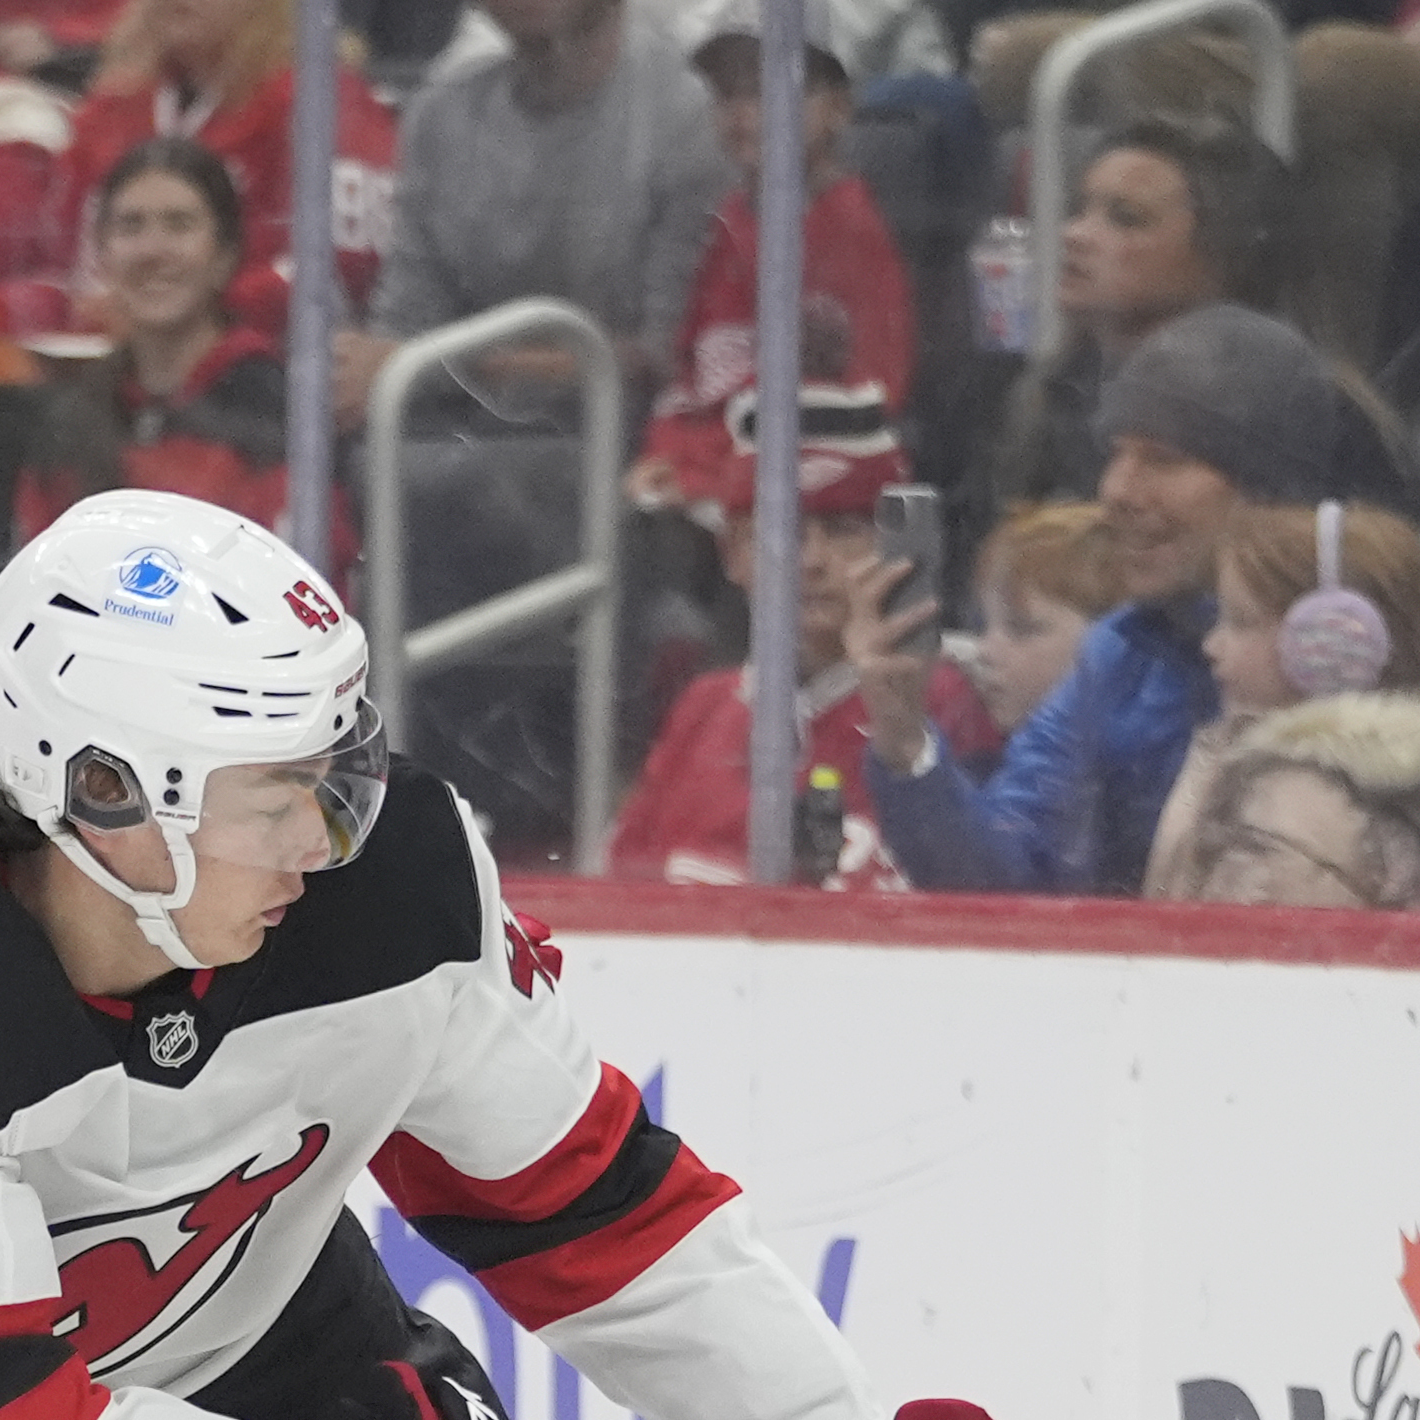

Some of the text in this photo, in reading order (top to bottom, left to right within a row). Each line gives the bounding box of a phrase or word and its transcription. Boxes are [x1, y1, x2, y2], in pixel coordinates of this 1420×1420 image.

[104, 598, 174, 627] Prudential
[282, 580, 340, 633] 43
[161, 1025, 187, 1058] NHL
